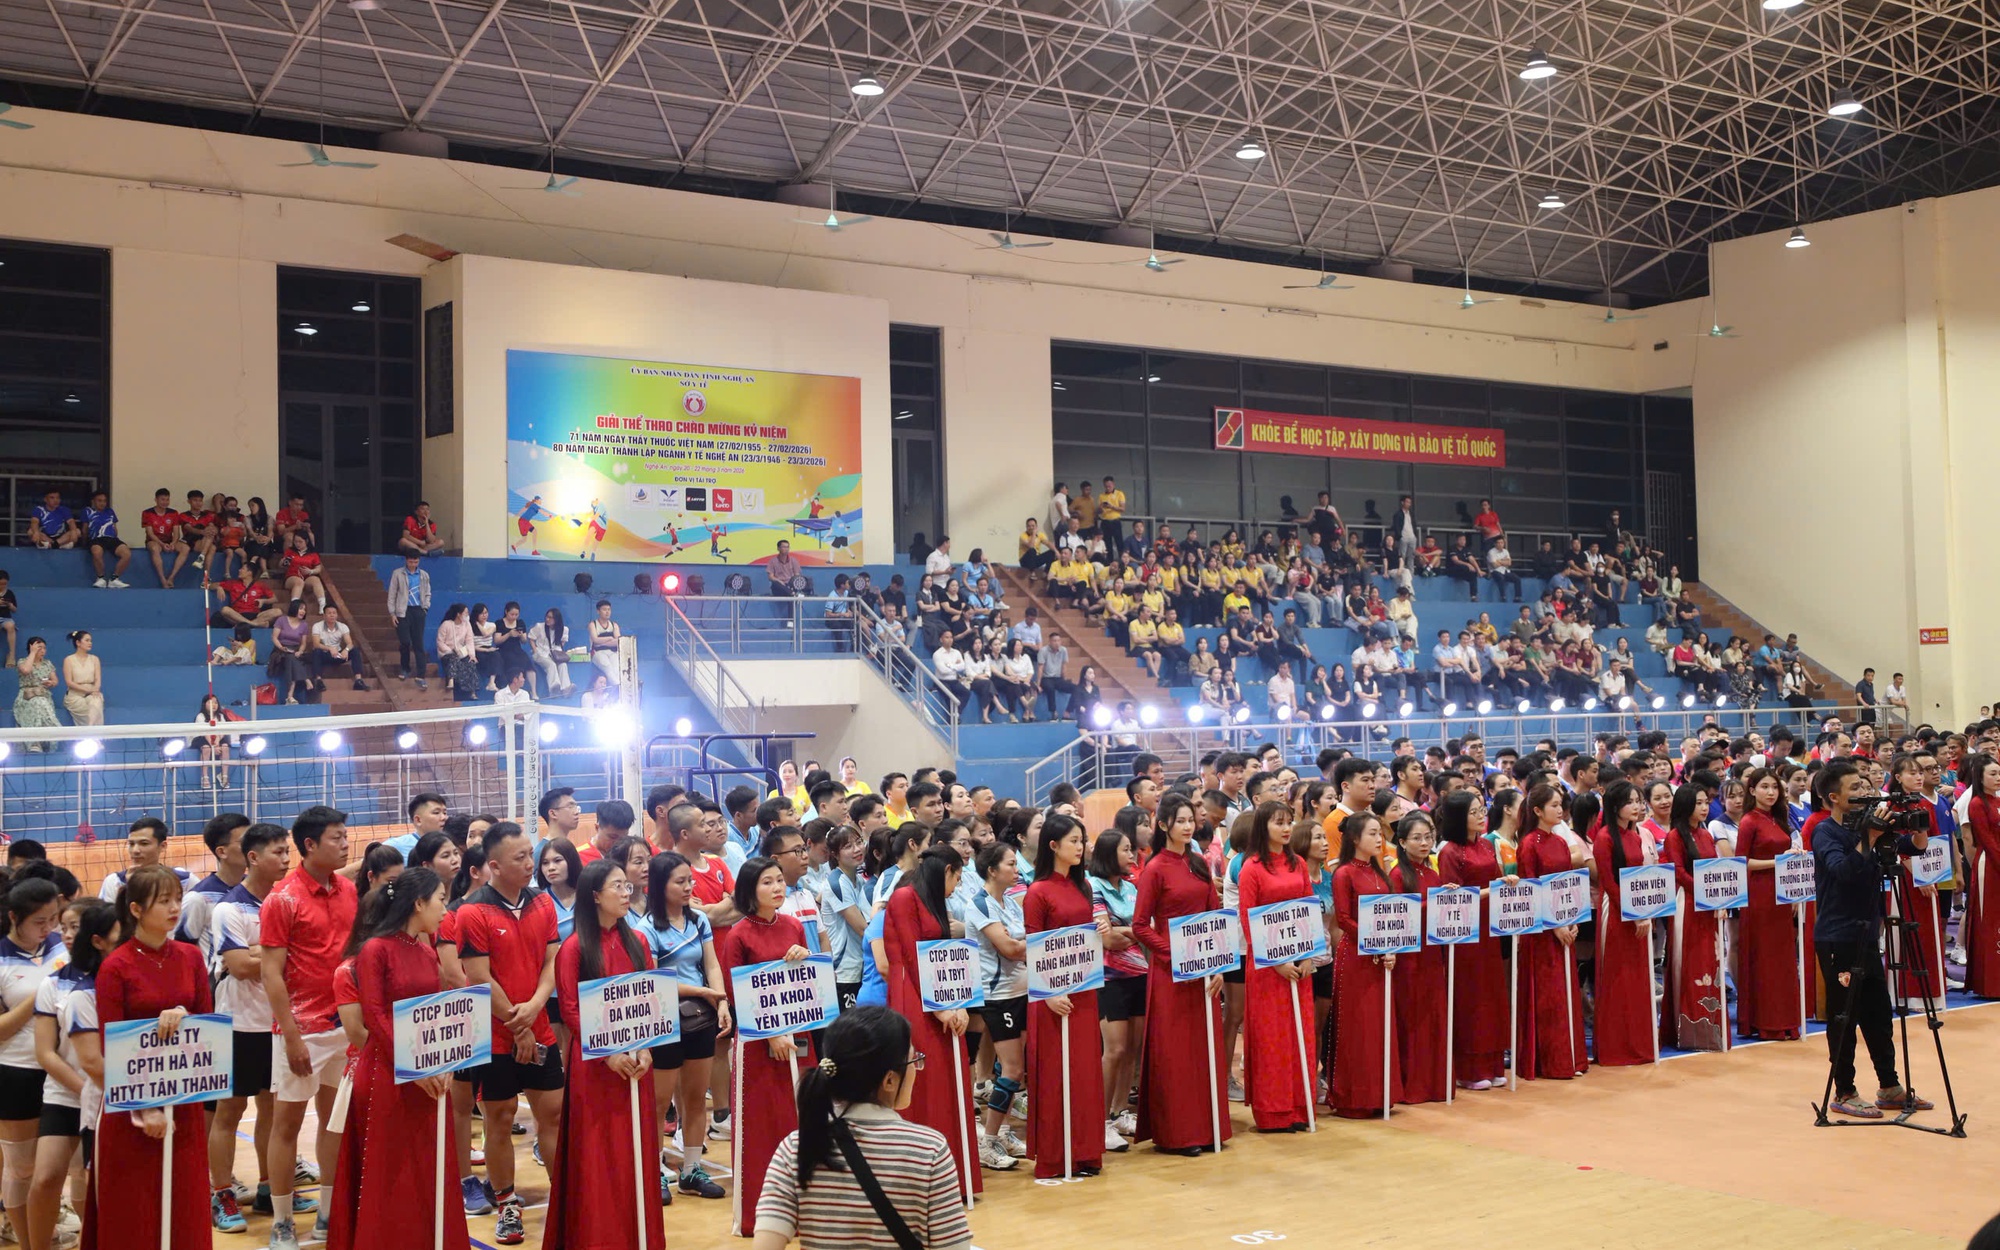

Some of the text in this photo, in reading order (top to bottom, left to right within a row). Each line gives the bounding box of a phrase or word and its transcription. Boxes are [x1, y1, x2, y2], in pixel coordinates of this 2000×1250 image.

[661, 369, 682, 377] NHÂN
[722, 374, 743, 383] NGHỆ
[597, 414, 787, 440] GIẢI THỂ THAO CHÀO MỪNG KỶ NIỆM
[570, 433, 812, 455] 71 NĂM NGÀY THẦY THUỐC VIỆT NAM (27/02/1955 27/02/2026)
[1251, 419, 1496, 458] KHỎE ĐỂ HỌC TẬP, XÂY DỰNG VÀ BẢO VỆ TỔ QUỐC
[553, 444, 563, 452] 80
[566, 444, 585, 453] NĂM
[588, 445, 609, 455] NGÀY
[612, 446, 639, 456] THÀNH
[641, 448, 655, 459] LẬP
[658, 449, 685, 459] NGÀNH
[695, 450, 703, 460] TẾ
[706, 452, 726, 463] NGHỆ
[741, 454, 780, 463] (23/3/1946
[788, 457, 826, 466] 23/3/2026)
[1932, 846, 1943, 858] VIỆN
[1787, 857, 1814, 871] BỆNH VIỆN
[1922, 860, 1942, 873] NỘI TIẾT
[1550, 876, 1580, 891] TRUNG TÂM
[1630, 877, 1666, 893] BỆNH VIỆN
[1704, 870, 1738, 886] BỆNH VIỆN
[1779, 873, 1800, 885] TRƯỜNG
[1801, 873, 1810, 885] ĐẠI
[1436, 892, 1472, 905] TRUNG TÂM
[1500, 884, 1533, 900] BỆNH VIỆN
[1560, 893, 1572, 904] Y TẾ
[1705, 882, 1738, 898] TÂM THẦN
[1785, 889, 1789, 898] Y
[1790, 888, 1804, 897] KHOA
[1502, 902, 1530, 913] ĐA KHOA
[1631, 892, 1666, 907] UNG BƯỚU
[1262, 905, 1309, 926] TRUNG TÂM
[1373, 900, 1408, 917] BỆNH VIỆN
[1448, 908, 1460, 921] Y TẾ
[1555, 907, 1578, 921] QUỲ HỢP
[1182, 917, 1226, 937] TRUNG TÂM
[1376, 919, 1405, 931] ĐA KHOA
[1436, 925, 1471, 937] NGHĨA ĐÀN
[1498, 916, 1534, 929] QUỲNH LƯU
[1280, 924, 1297, 939] Y TẾ
[1045, 931, 1085, 954] BỆNH VIỆN
[1197, 935, 1214, 952] Y TẾ
[1364, 933, 1417, 948] THÀNH PHỐ VINH
[929, 947, 969, 963] CTCP DƯỢC
[1267, 940, 1314, 960] HOÀNG MAI
[1036, 948, 1095, 973] RĂNG HÀM MẶT
[1179, 952, 1234, 974] TƯƠNG DƯƠNG
[751, 964, 816, 990] BỆNH VIỆN
[937, 966, 965, 982] VÀ TBYT
[1049, 971, 1083, 989] NGHỆ AN
[603, 977, 654, 1004] BỆNH VIỆN
[760, 987, 814, 1009] ĐA KHOA
[934, 984, 973, 1002] ĐỒNG TÂM
[413, 997, 473, 1024] CTCP DƯỢC
[609, 1002, 651, 1023] ĐA KHOA
[755, 1006, 824, 1031] YÊN THÀNH
[1003, 1012, 1014, 1028] 5
[184, 1027, 200, 1044] TY
[422, 1023, 465, 1045] VÀ TBYT
[589, 1016, 673, 1049] KHU VỰC TÂY BẮC
[127, 1051, 212, 1076] CPTH HÀ AN
[415, 1044, 472, 1070] LINH LANG
[110, 1074, 228, 1103] HTYT TÂN THANH
